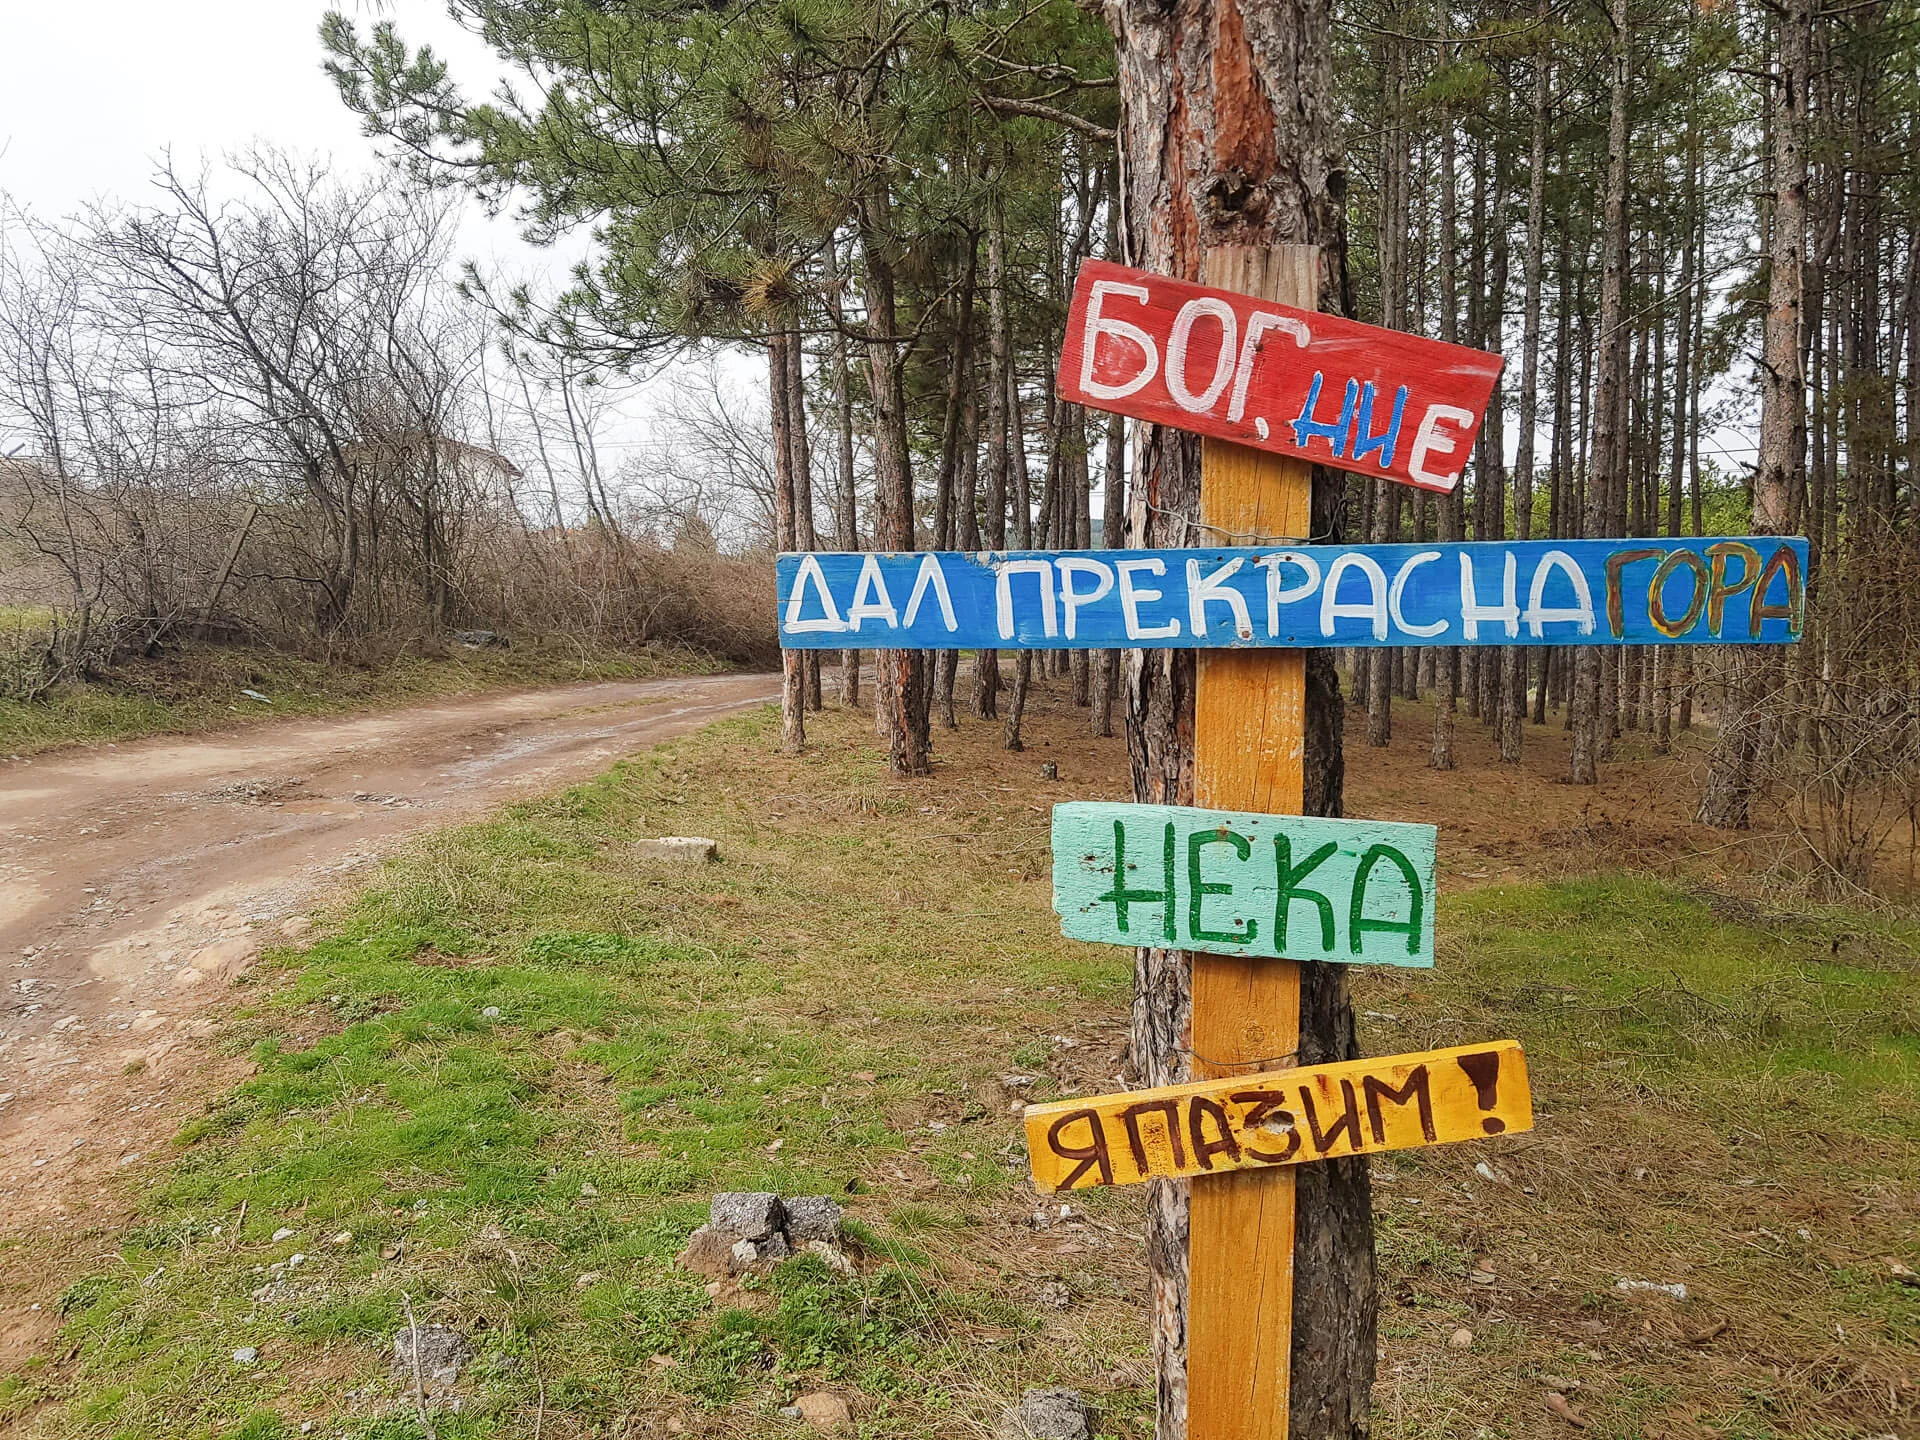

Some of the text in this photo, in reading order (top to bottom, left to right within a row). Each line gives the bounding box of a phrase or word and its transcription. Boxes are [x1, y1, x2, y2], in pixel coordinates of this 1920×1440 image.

[1291, 370, 1409, 468] НИ
[1408, 403, 1474, 490] Е
[782, 541, 1803, 641] ДАЛ ПРЕКРАСНА ГОРА
[1099, 819, 1424, 955] НЕКА
